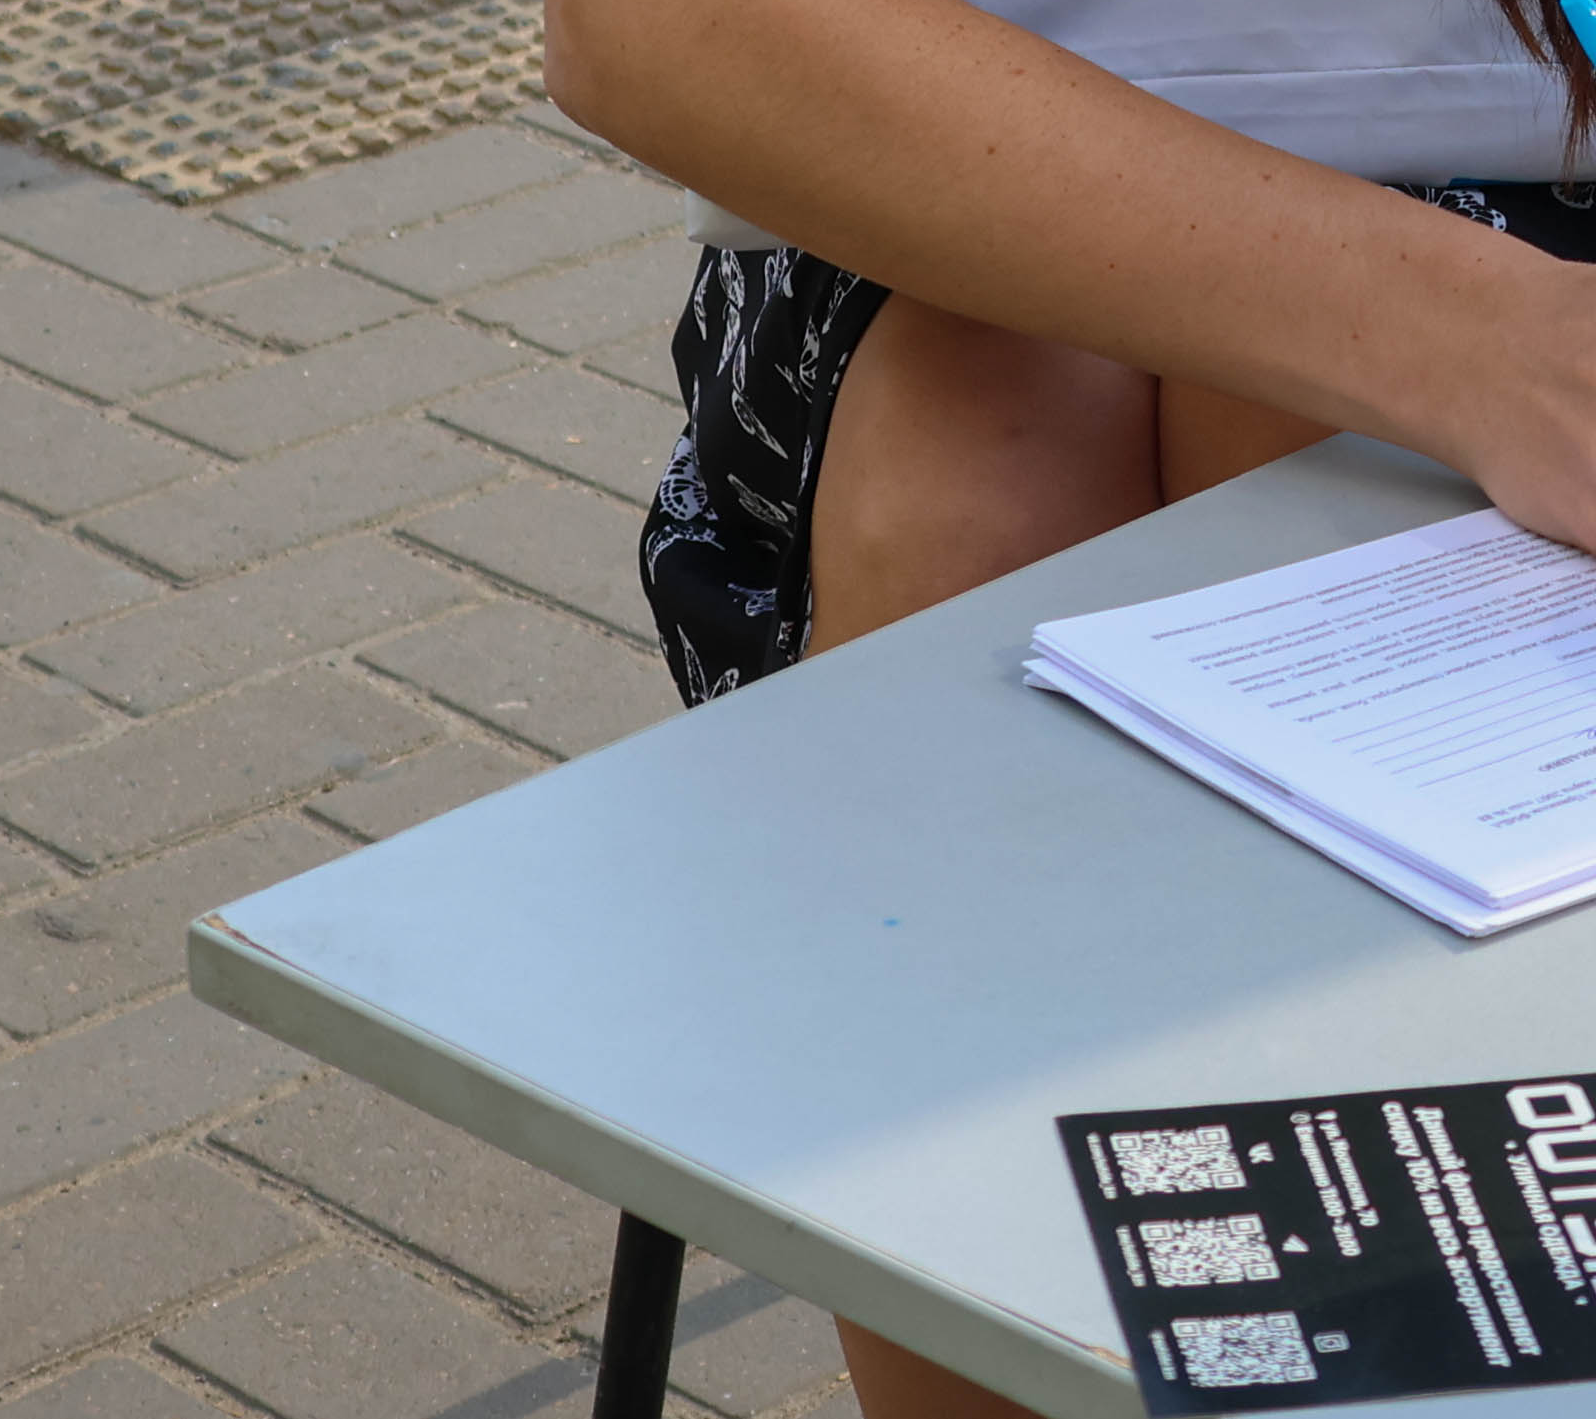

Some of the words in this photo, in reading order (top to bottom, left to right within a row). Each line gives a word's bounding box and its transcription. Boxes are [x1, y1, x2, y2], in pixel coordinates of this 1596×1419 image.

[1375, 1100, 1424, 1157] скидку
[1410, 1106, 1468, 1171] Данный
[1401, 1157, 1442, 1193] 10%
[1435, 1170, 1491, 1226] флаер
[1353, 1208, 1381, 1227] 70
[1417, 1193, 1446, 1215] на
[1503, 1153, 1558, 1223] УЛИЧНАЯ
[1533, 1224, 1588, 1291] ОДЕЖДА
[1425, 1215, 1463, 1256] весь
[1440, 1256, 1513, 1369] ассортимент
[1460, 1226, 1544, 1358] предоставляет
